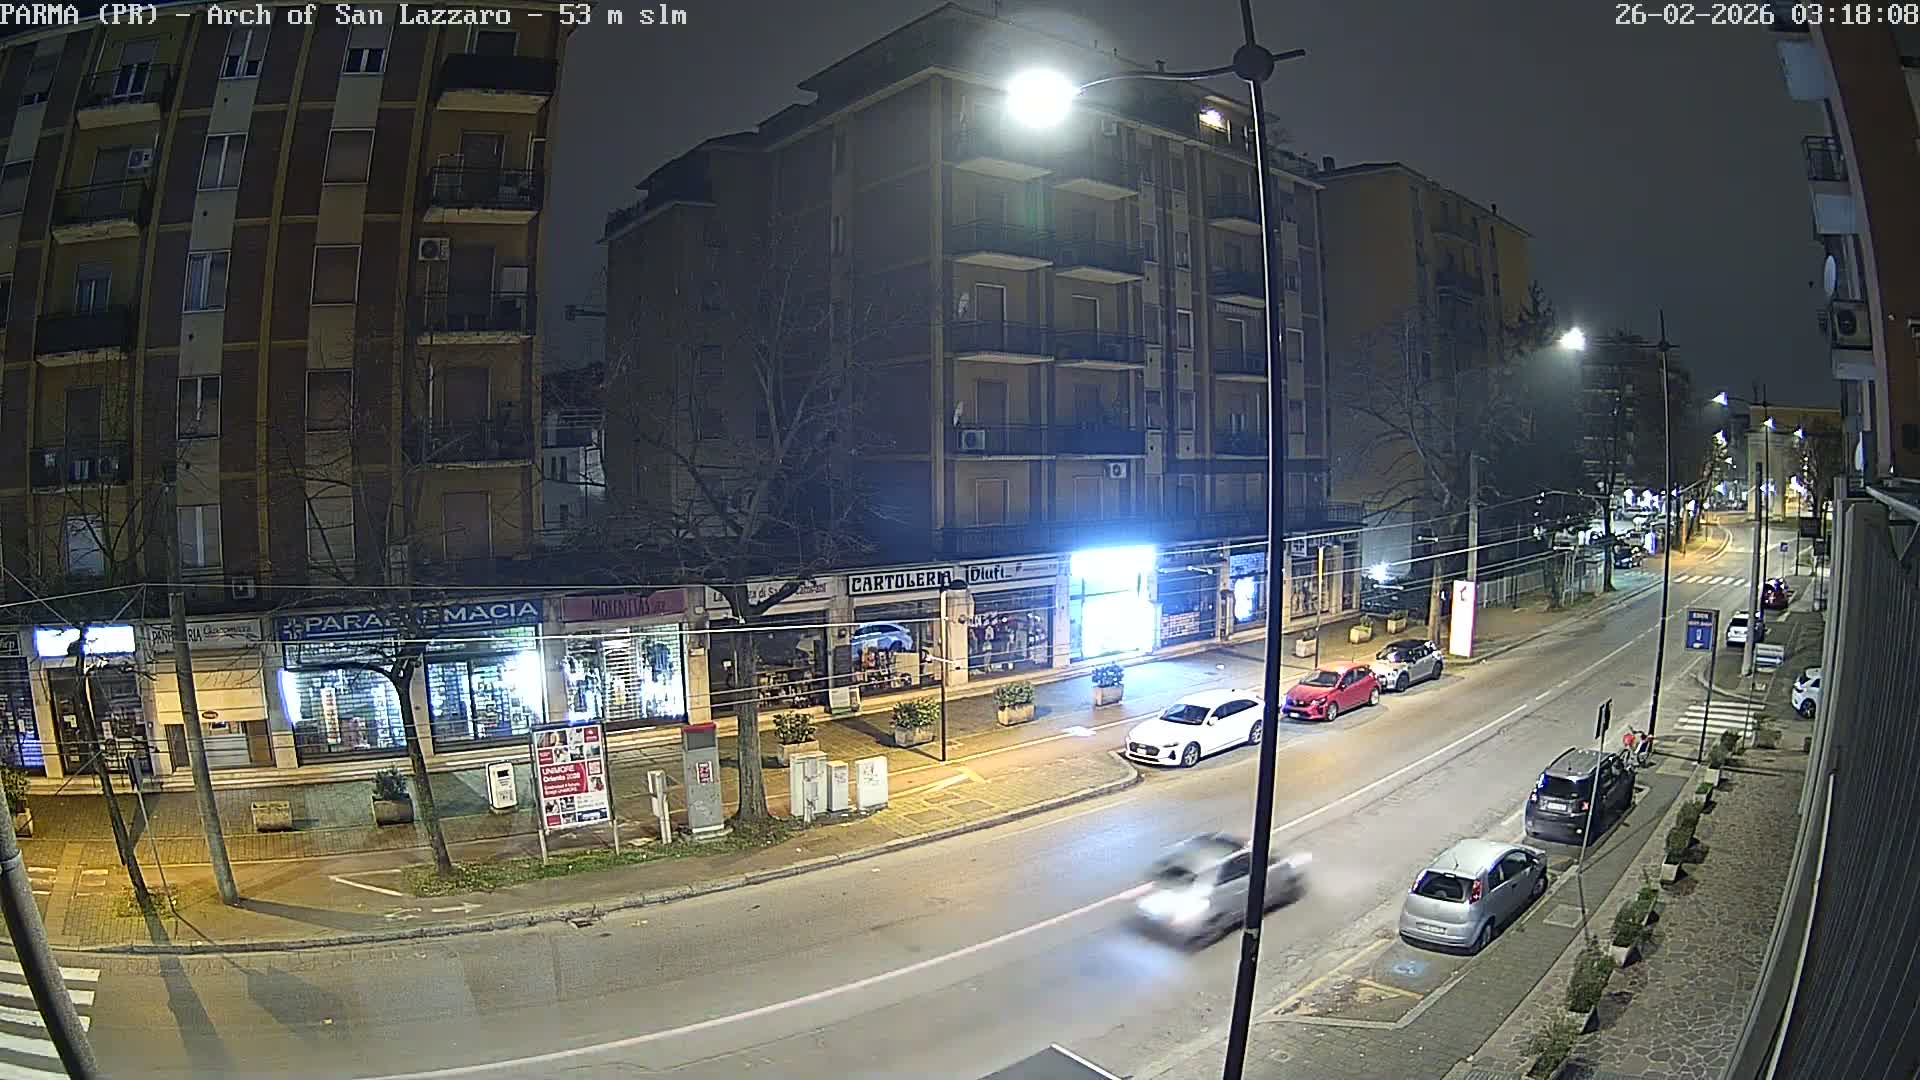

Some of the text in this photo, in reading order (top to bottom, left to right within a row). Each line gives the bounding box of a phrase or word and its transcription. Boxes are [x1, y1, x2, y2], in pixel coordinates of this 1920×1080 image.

[851, 571, 952, 593] CARTOLERIA
[152, 627, 202, 643] PANRIA
[541, 765, 576, 776] UNIMORE
